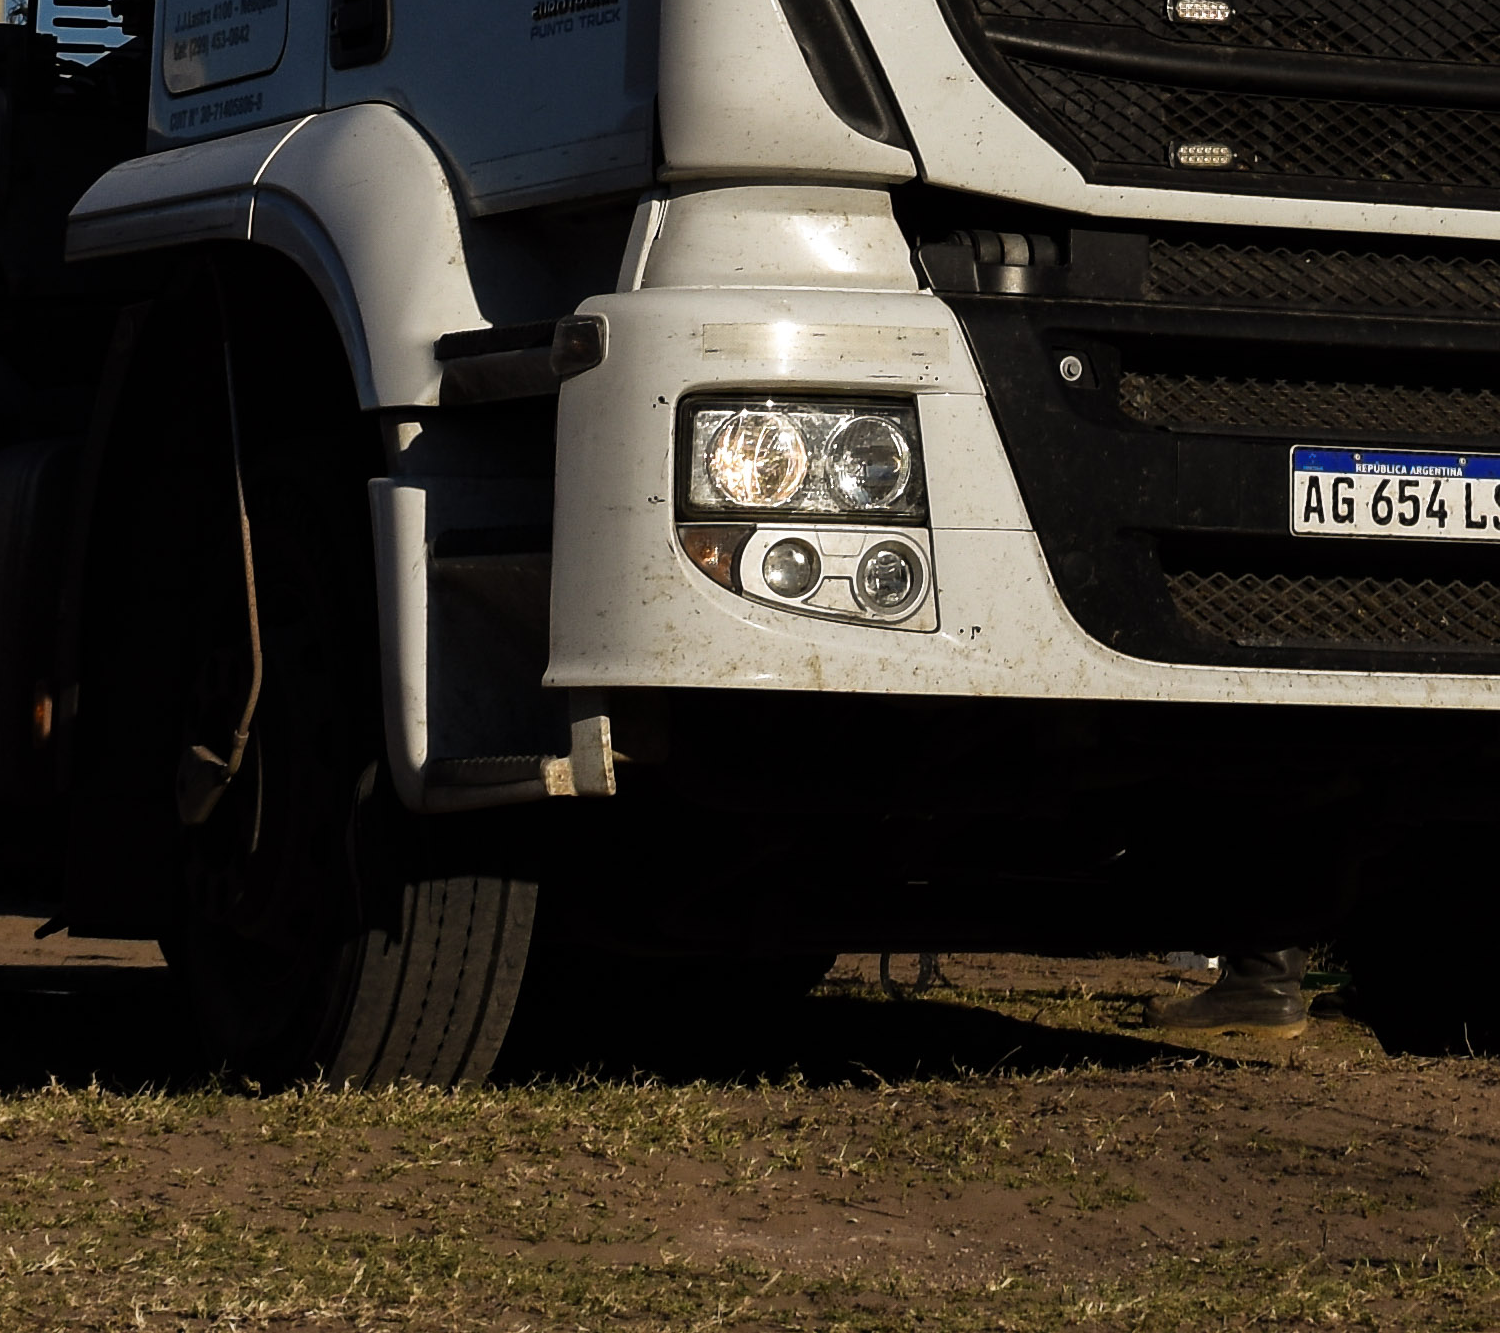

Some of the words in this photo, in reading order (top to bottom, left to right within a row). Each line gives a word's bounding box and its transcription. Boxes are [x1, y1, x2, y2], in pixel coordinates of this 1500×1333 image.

[530, 18, 573, 41] PUNTO
[579, 8, 621, 29] TRUCK
[1355, 461, 1408, 475] REPÚBLICA
[1410, 465, 1463, 477] ARGENTINA
[1303, 475, 1355, 524] AG
[1371, 479, 1448, 528] 654
